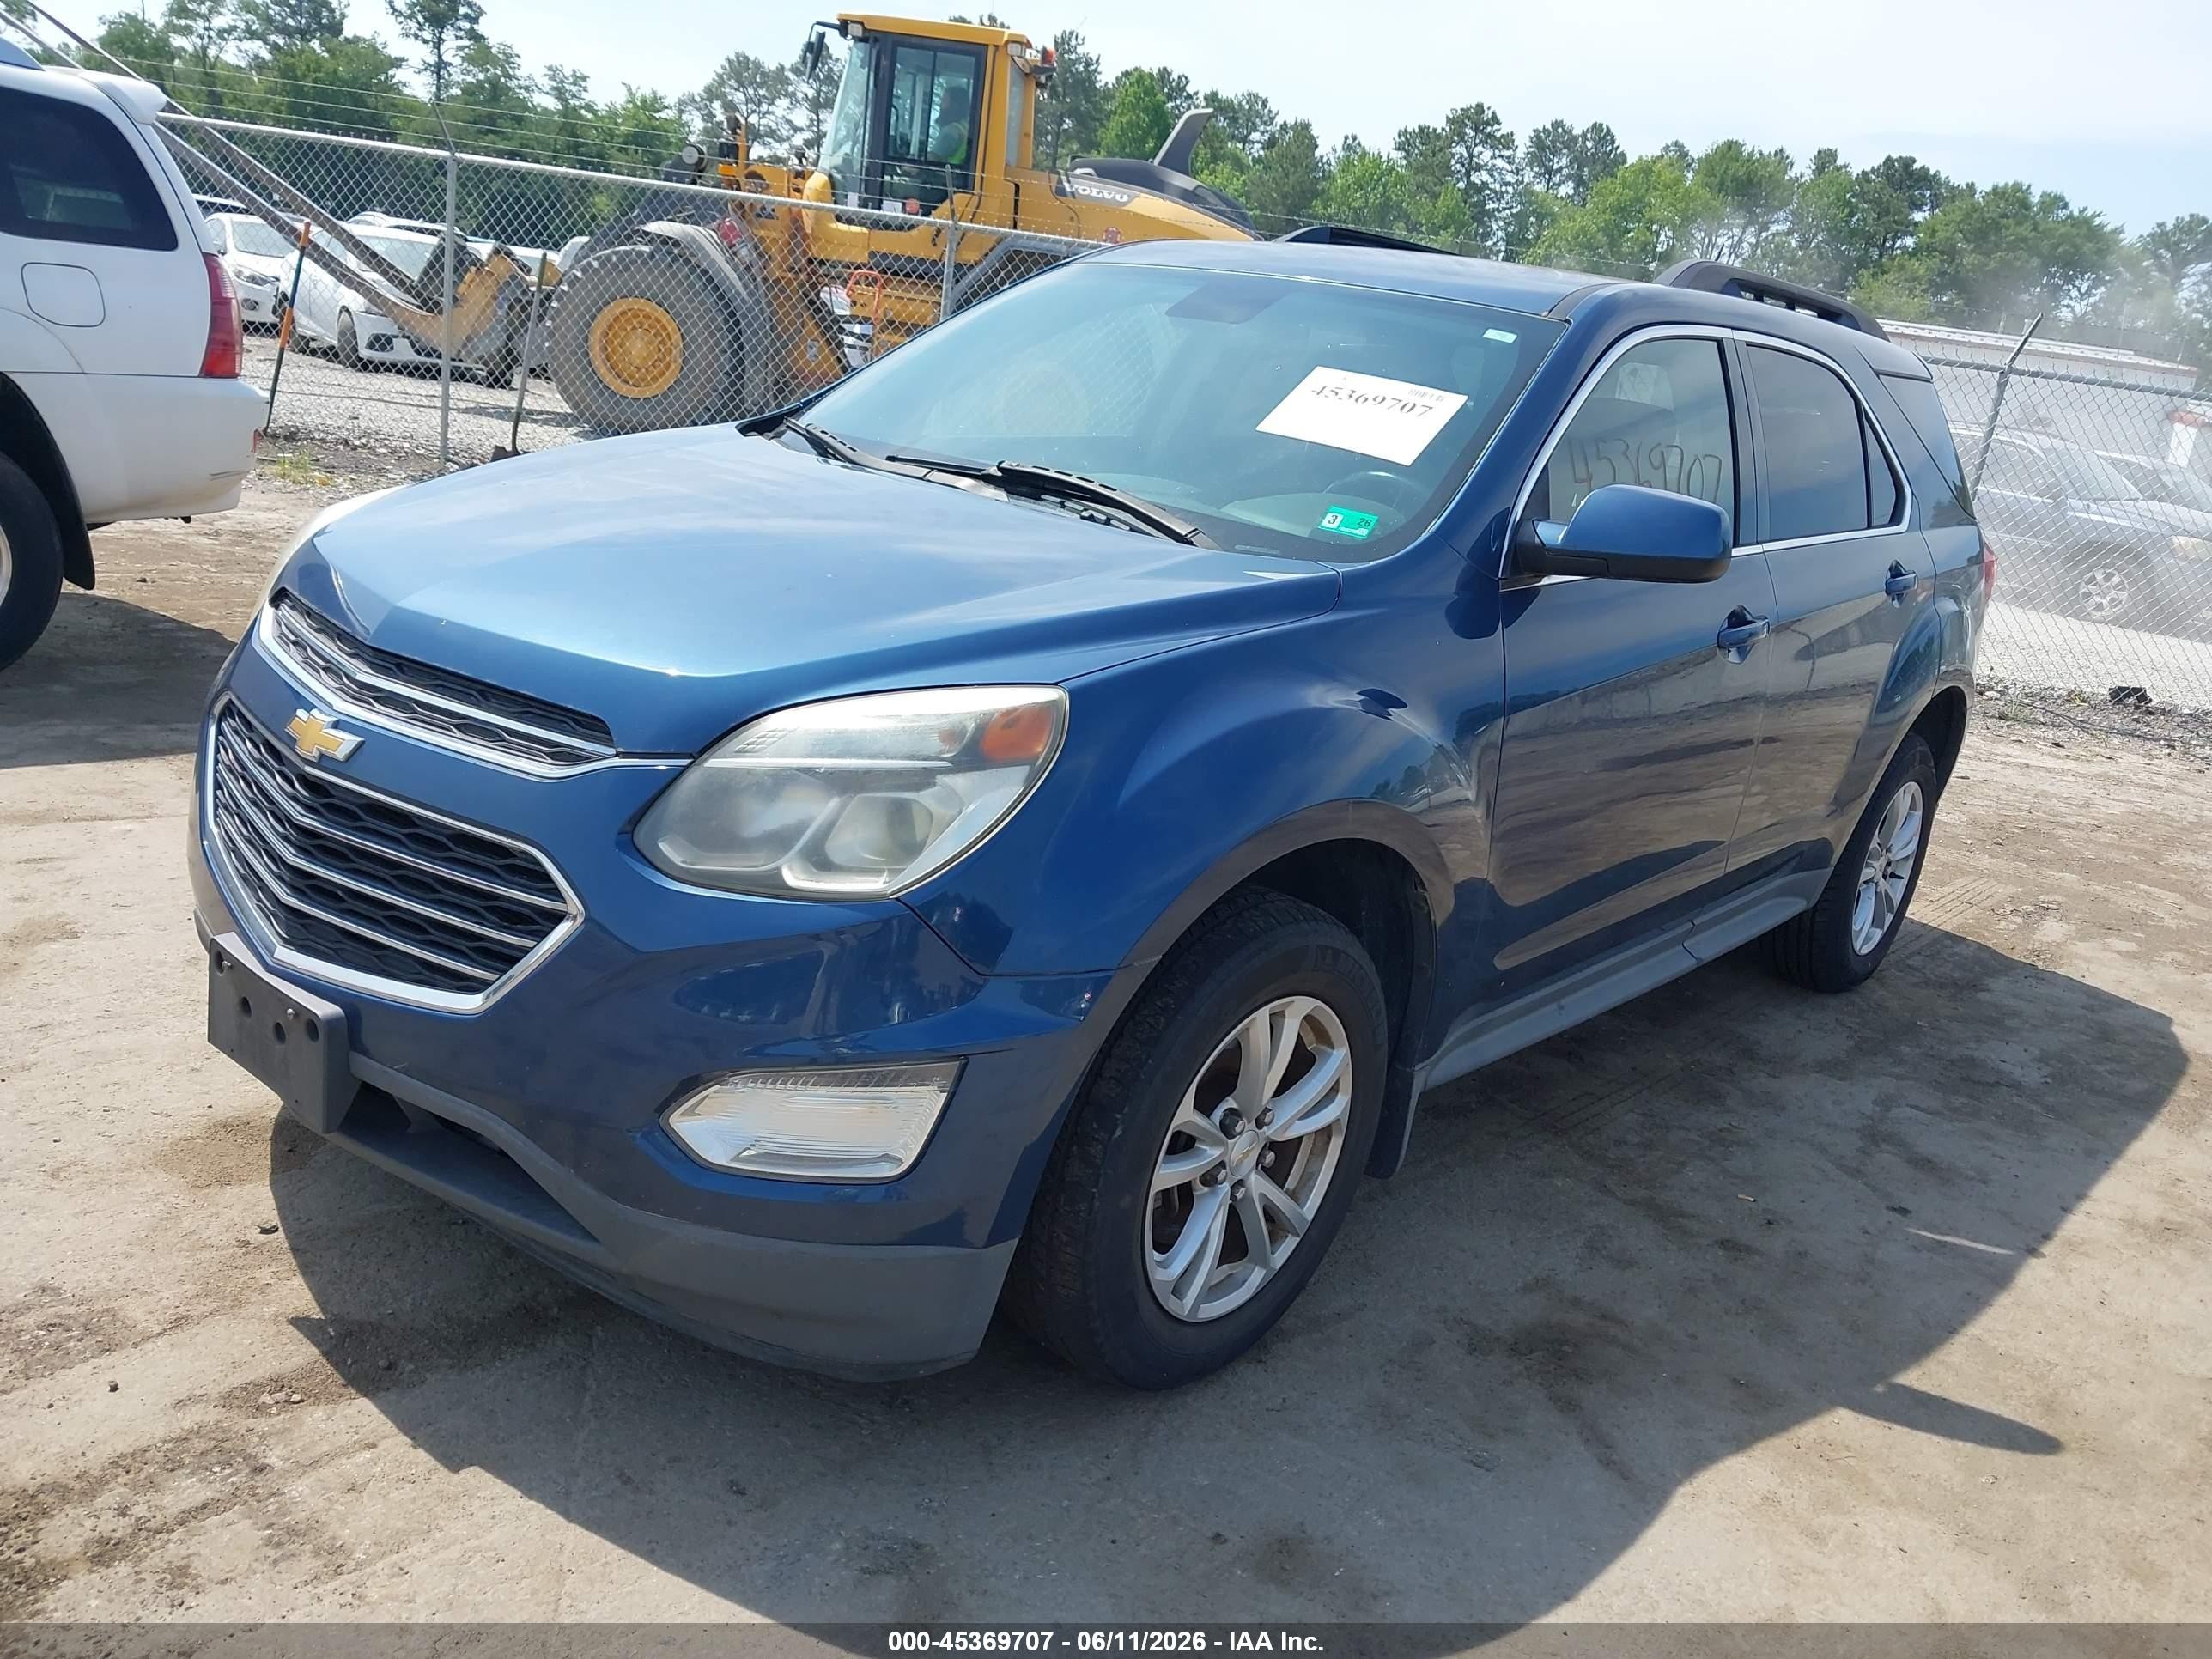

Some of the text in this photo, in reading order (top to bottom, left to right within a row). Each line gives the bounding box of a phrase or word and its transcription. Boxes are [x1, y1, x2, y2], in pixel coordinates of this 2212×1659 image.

[1064, 182, 1129, 203] VOLVO
[1311, 385, 1434, 417] 45369707
[1328, 514, 1372, 527] 3 26
